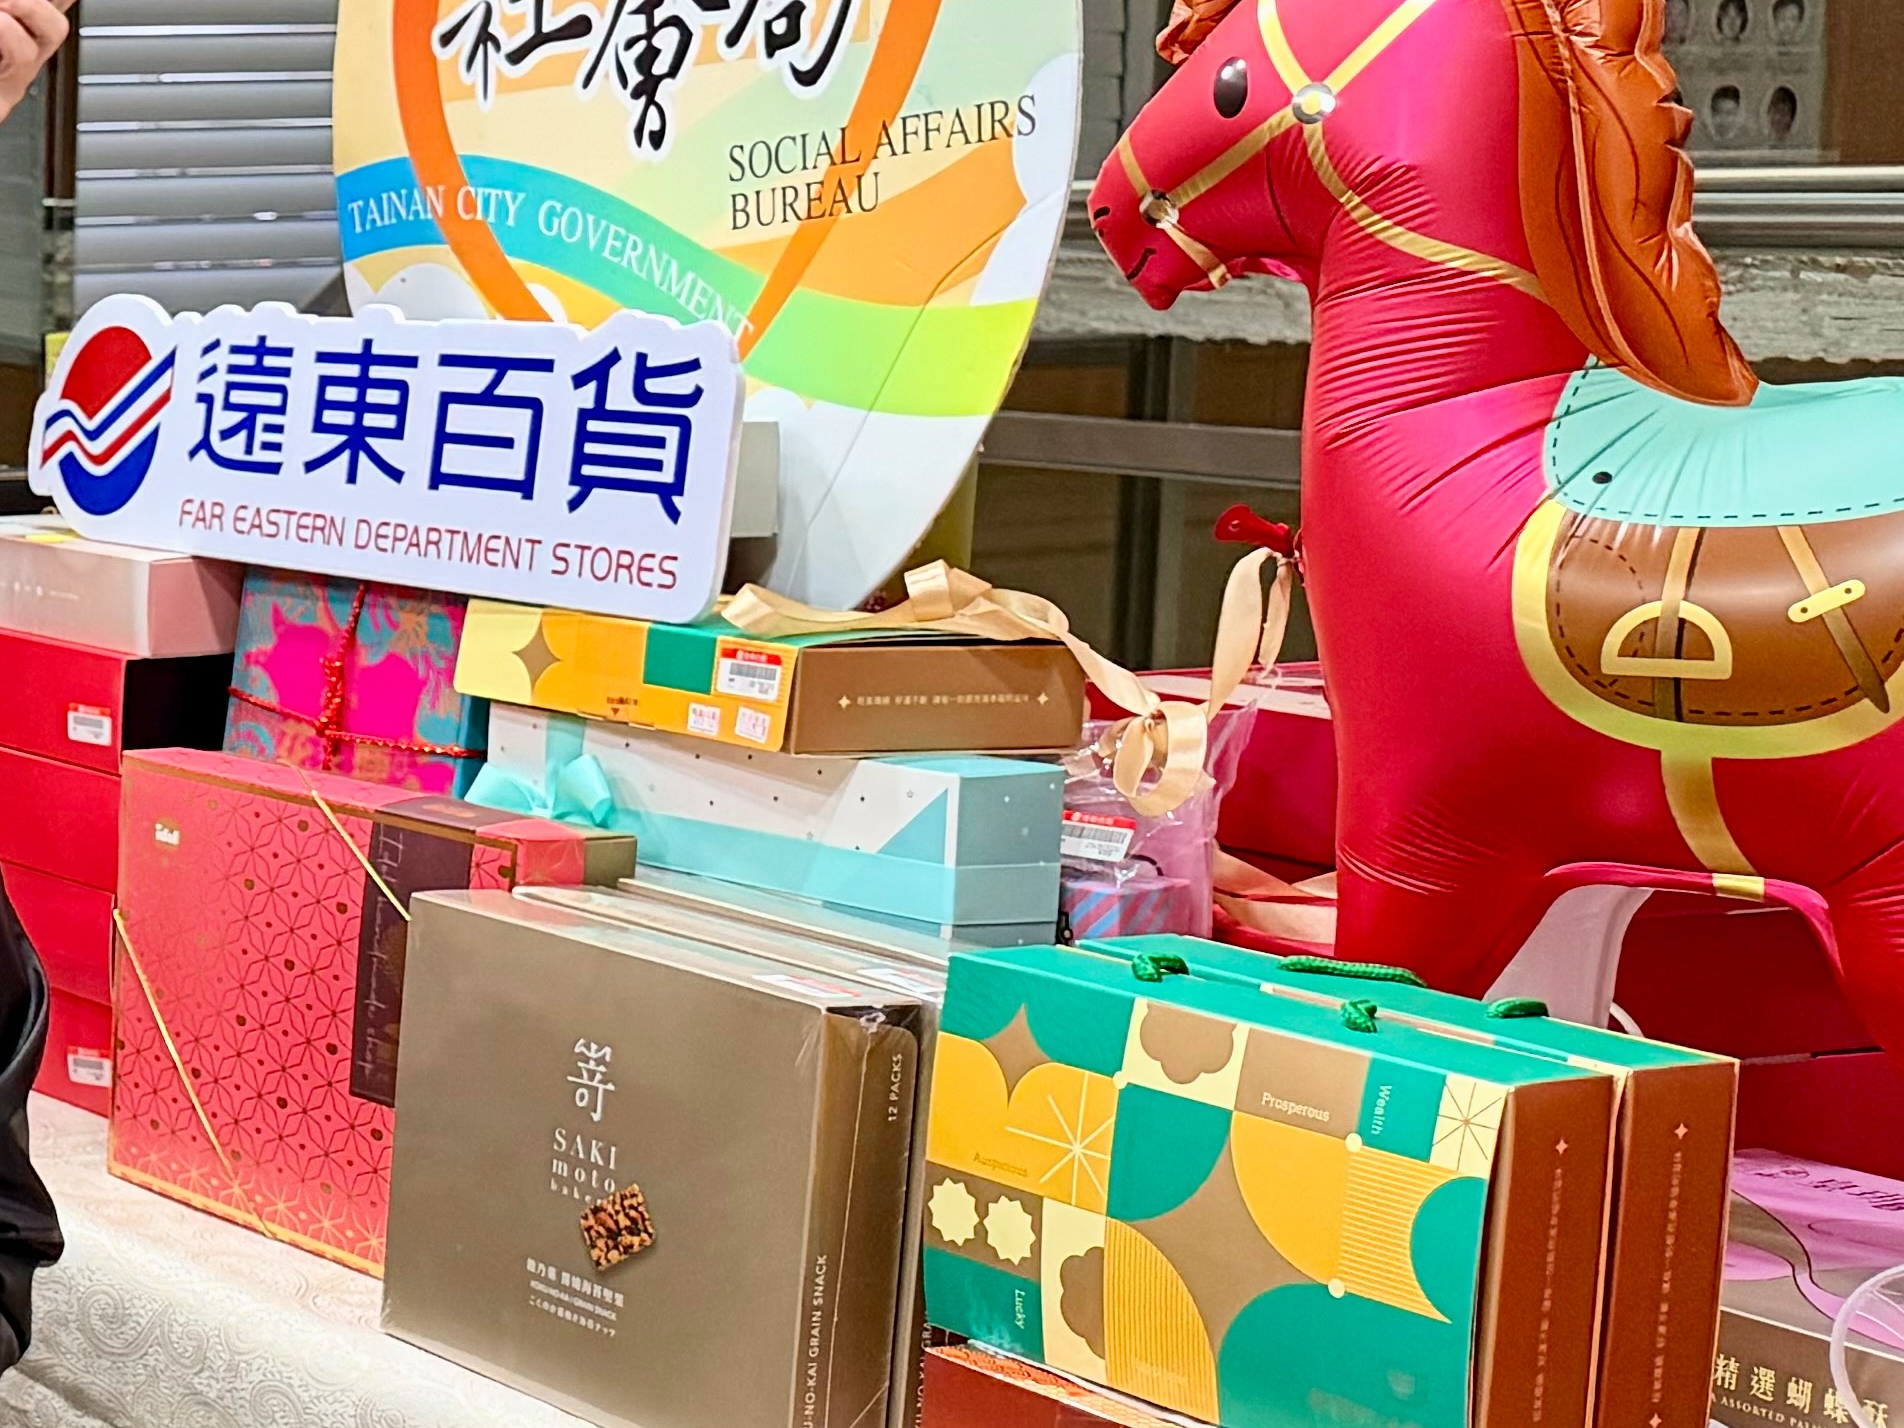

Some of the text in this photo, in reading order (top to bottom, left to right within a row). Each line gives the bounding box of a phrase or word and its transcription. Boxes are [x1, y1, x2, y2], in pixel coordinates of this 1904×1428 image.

[728, 93, 1037, 183] SOCIAL AFFAIRS
[730, 172, 881, 232] BUREAU
[348, 185, 754, 340] TAINAN CITY GOVERNMENT
[188, 334, 704, 524] 遠東百貨
[179, 498, 679, 589] FAR EASTERN DEPARTMENT STORES
[887, 1052, 903, 1122] 12 PACKS
[1261, 1091, 1330, 1123] Prosperous
[1371, 1084, 1392, 1135] Wealth
[553, 1127, 616, 1170] SAKI
[552, 1158, 616, 1193] moto
[813, 1254, 827, 1303] SNACK
[808, 1309, 823, 1358] GRAIN
[1014, 1289, 1025, 1330] Lucky
[1721, 1397, 1786, 1423] ASSORTED
